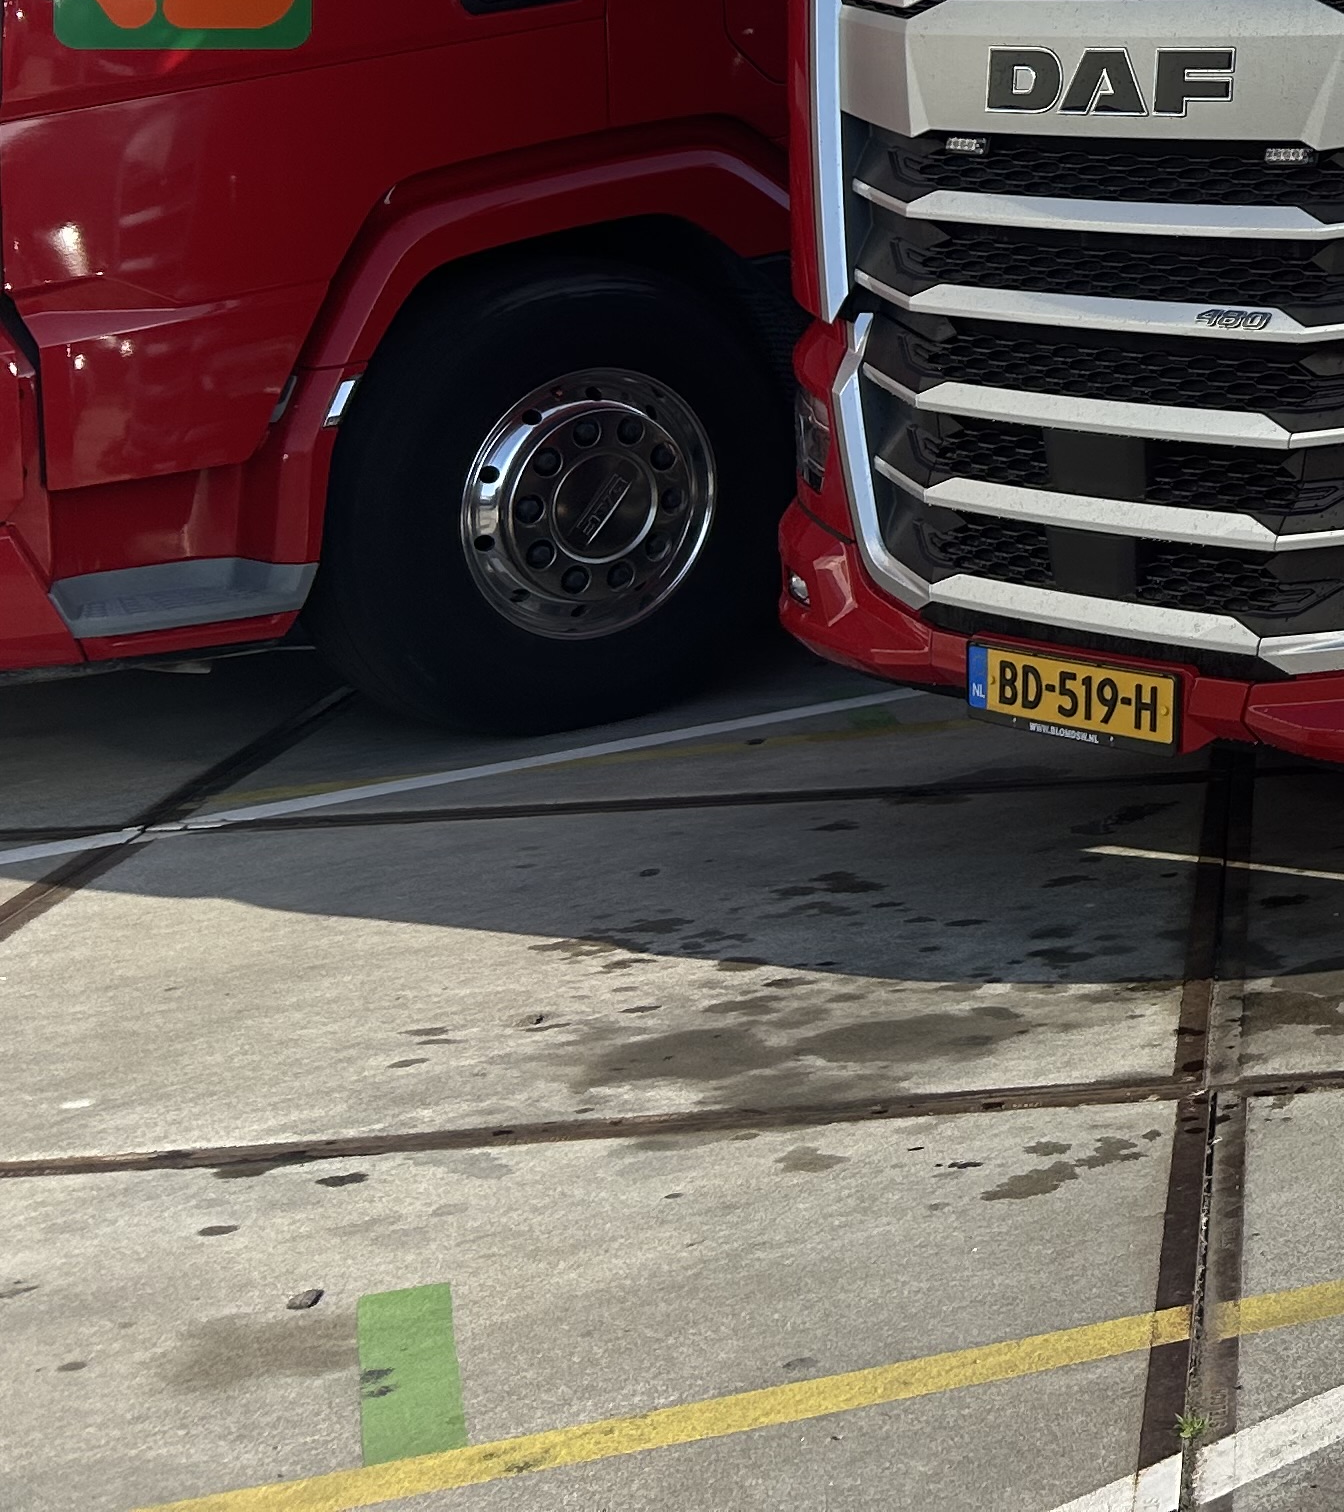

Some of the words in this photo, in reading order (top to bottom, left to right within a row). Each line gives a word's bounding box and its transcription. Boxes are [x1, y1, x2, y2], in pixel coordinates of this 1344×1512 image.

[985, 44, 1236, 117] DAF
[1195, 309, 1273, 331] 480
[972, 682, 986, 699] NL
[999, 660, 1158, 733] BD-519-H
